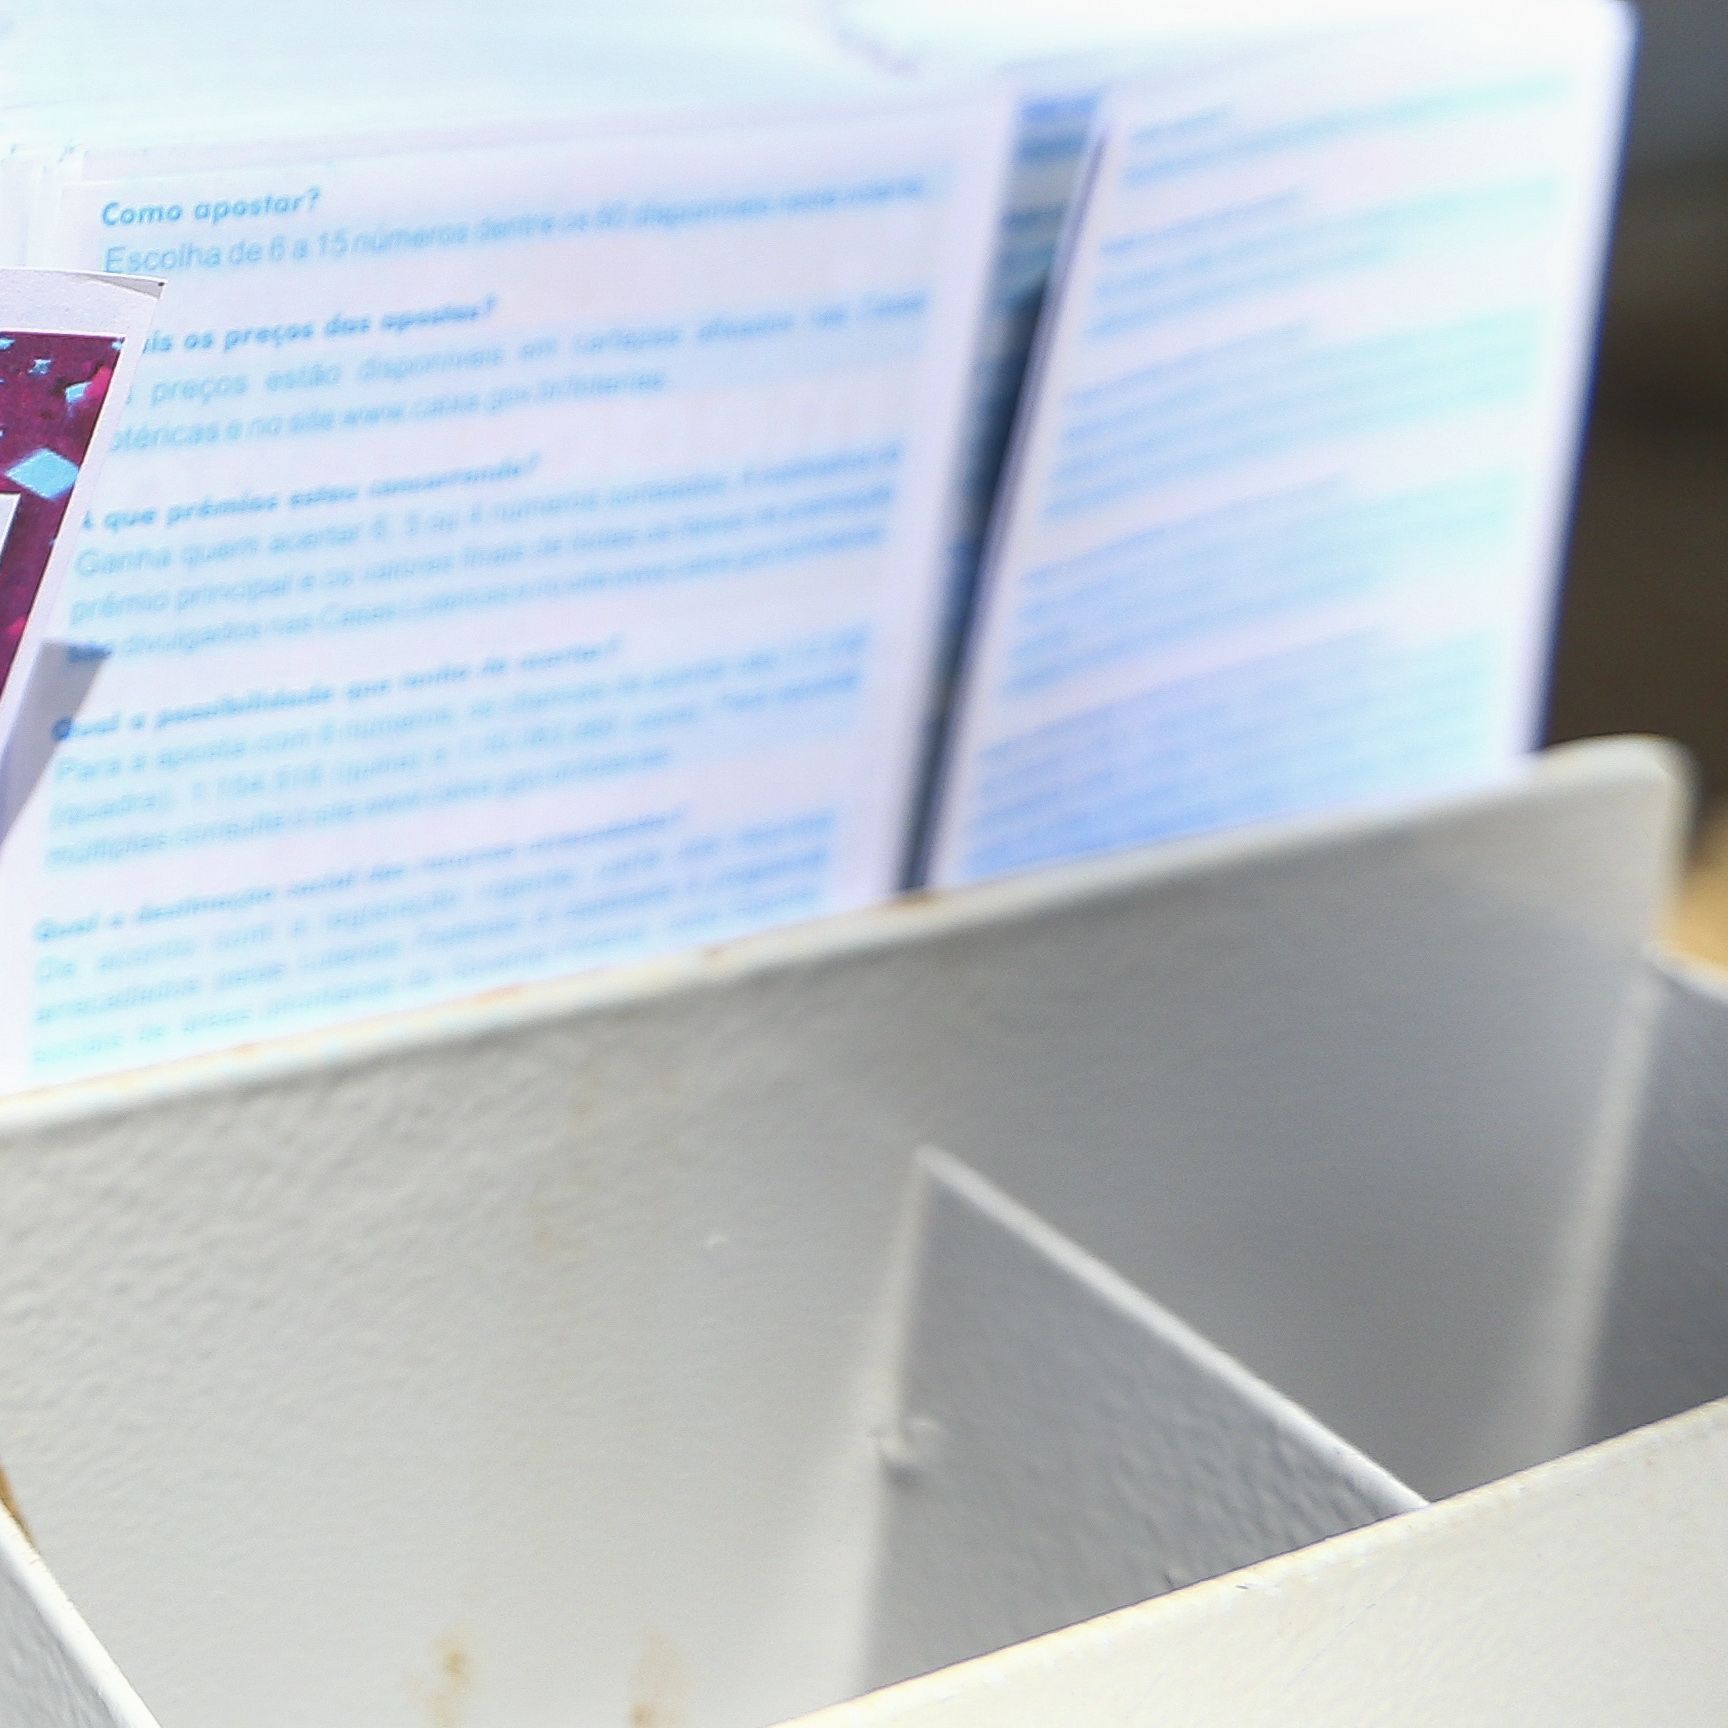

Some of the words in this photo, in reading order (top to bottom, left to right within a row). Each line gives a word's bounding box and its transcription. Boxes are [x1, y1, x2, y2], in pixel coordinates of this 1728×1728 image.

[102, 201, 182, 226] Como
[194, 186, 321, 225] apostar?
[104, 244, 221, 272] Escolha
[228, 241, 261, 265] de
[318, 232, 349, 258] 15
[184, 330, 213, 350] os
[224, 319, 314, 351] preços
[324, 311, 370, 338] das
